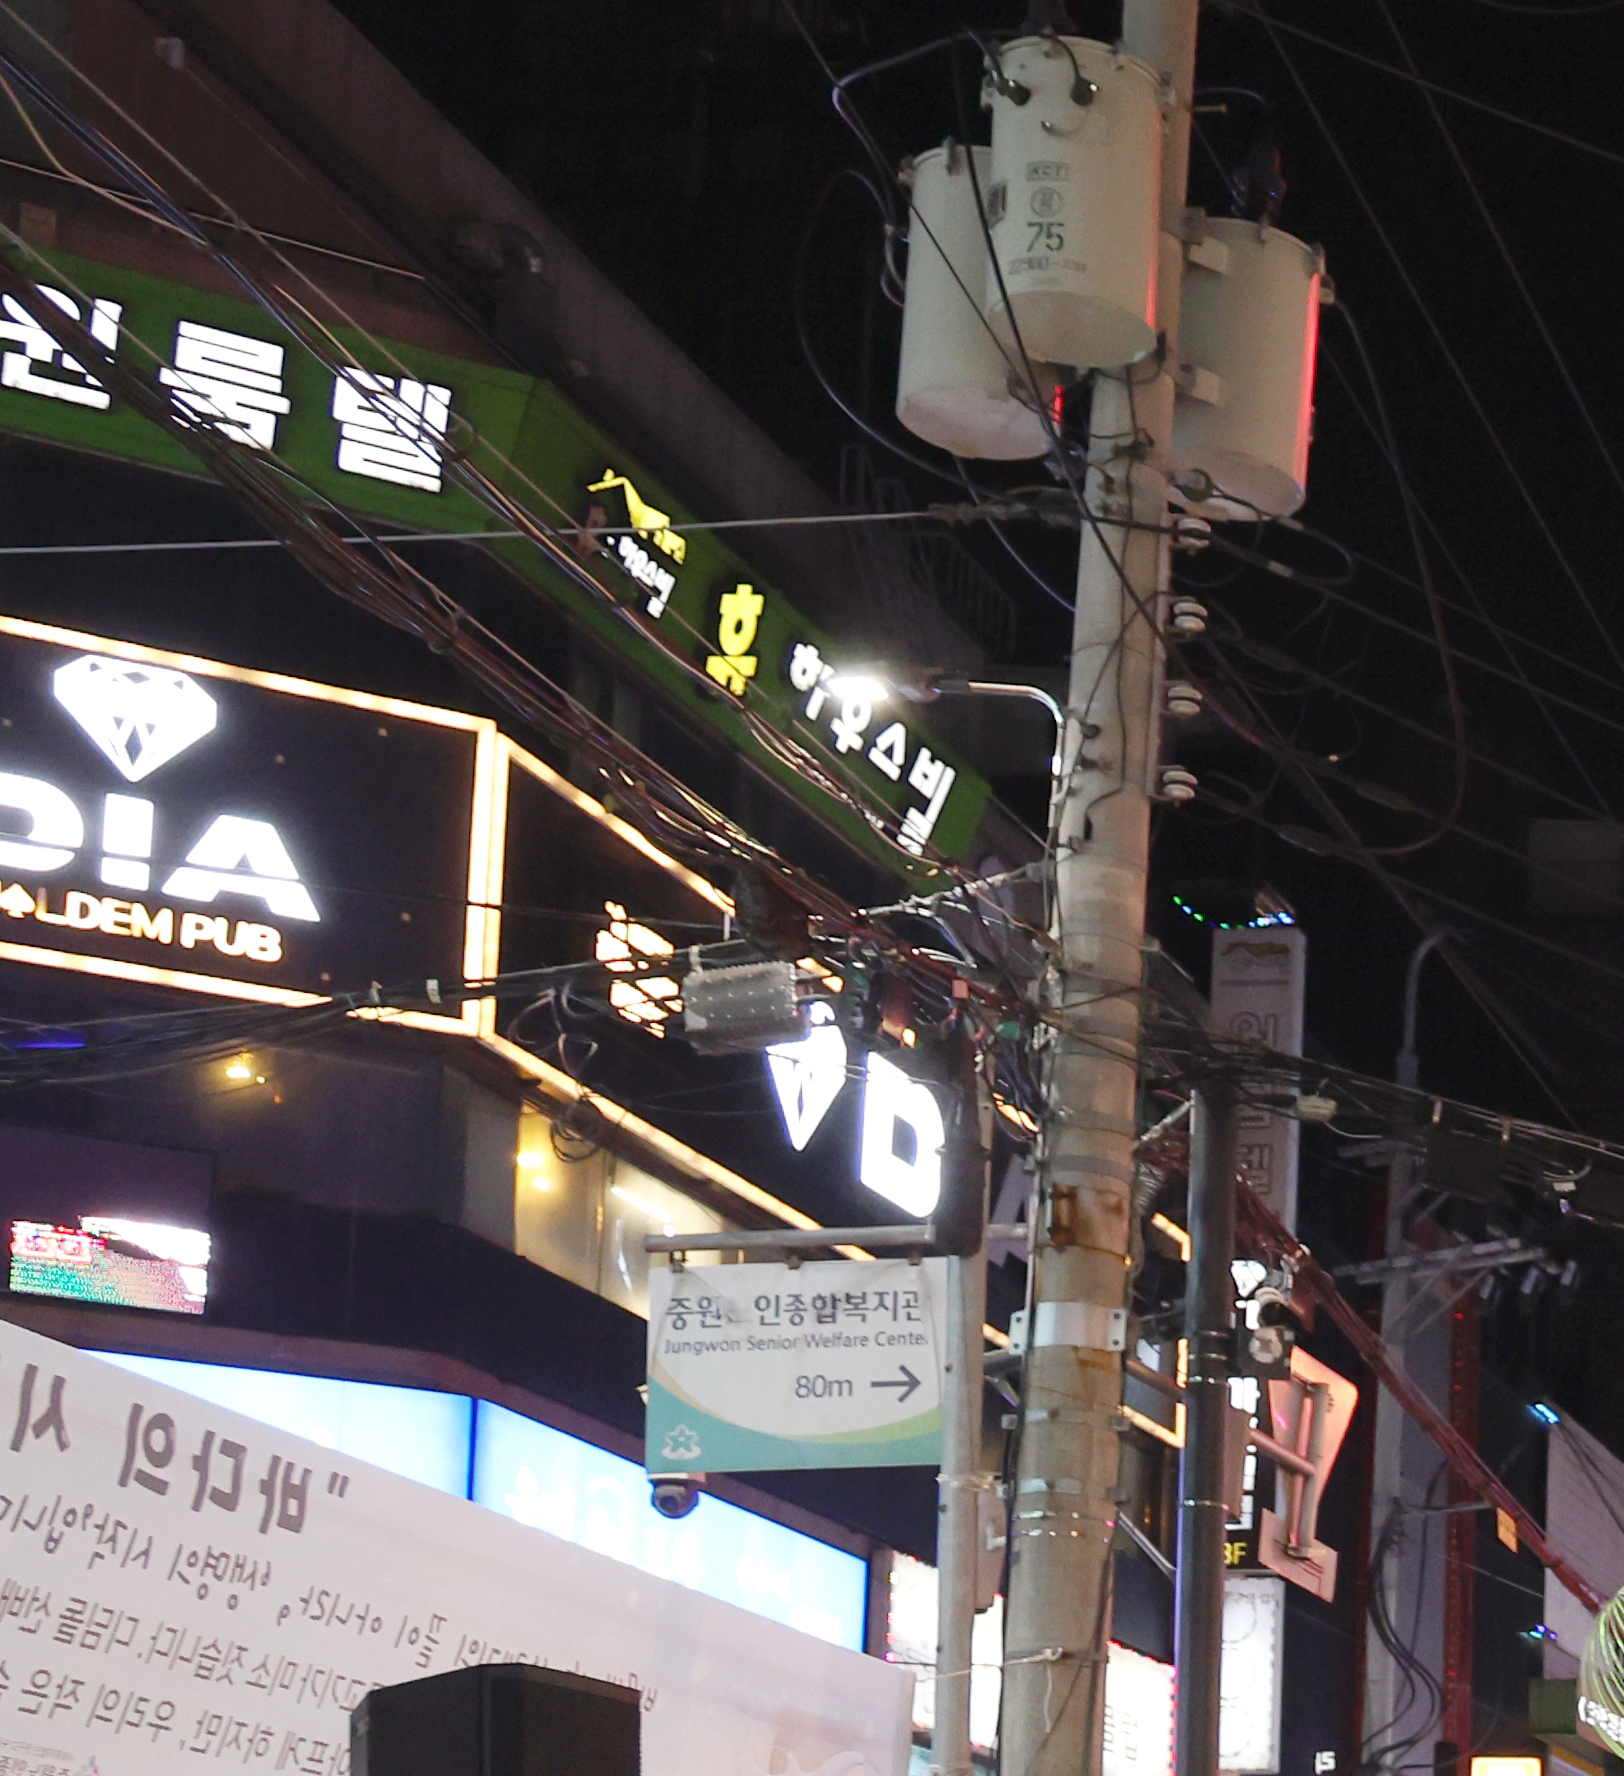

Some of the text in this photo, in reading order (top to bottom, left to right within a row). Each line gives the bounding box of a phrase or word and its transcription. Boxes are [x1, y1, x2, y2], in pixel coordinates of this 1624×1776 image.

[1026, 221, 1064, 252] 75
[180, 911, 283, 964] PUB
[665, 1289, 922, 1331] 중원인종합복지관
[664, 1336, 742, 1356] Jungwon
[747, 1334, 800, 1351] Senior
[805, 1331, 869, 1348] Welfare
[795, 1373, 854, 1399] 80m
